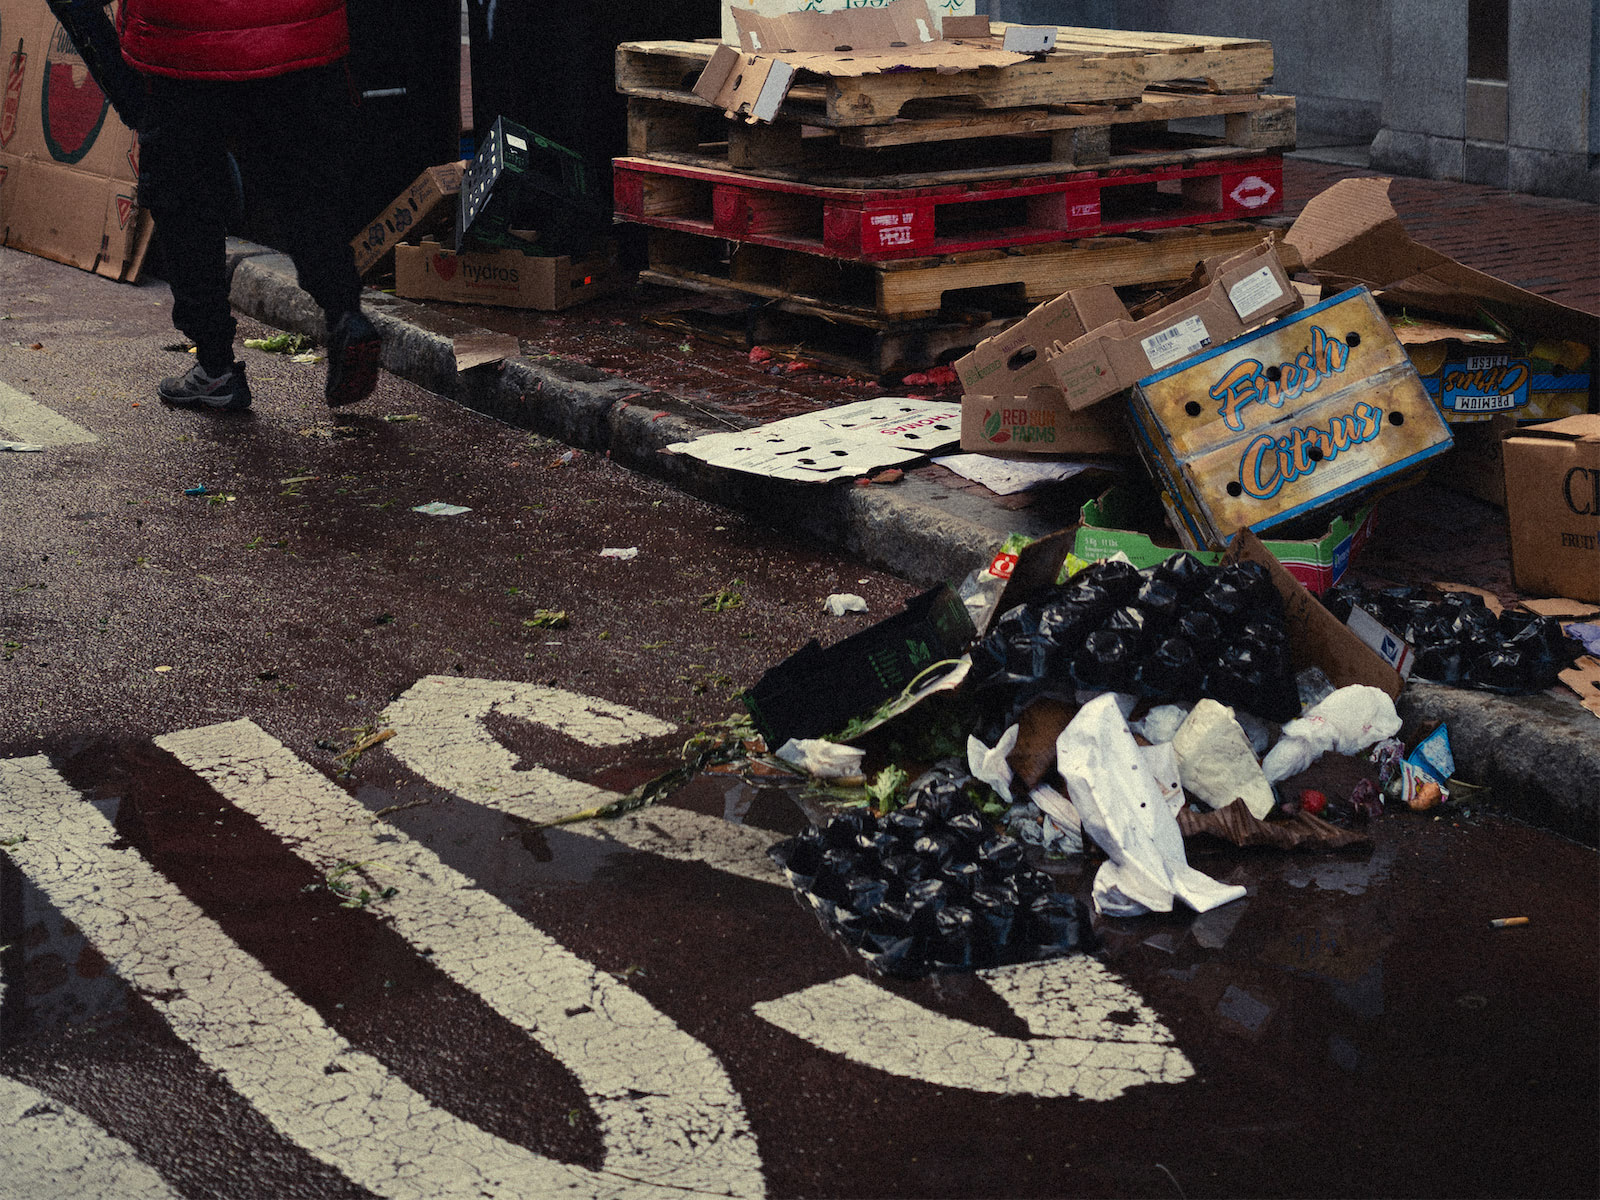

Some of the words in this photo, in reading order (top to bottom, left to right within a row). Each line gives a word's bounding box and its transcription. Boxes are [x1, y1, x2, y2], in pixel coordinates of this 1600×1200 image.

[462, 260, 520, 283] hydros
[1471, 356, 1509, 370] FRESH
[1209, 325, 1350, 432] Fresh
[1444, 364, 1529, 396] Citrus
[1460, 395, 1510, 409] PREMIUM
[880, 412, 958, 436] THOMAS
[1002, 408, 1027, 426] RED
[1012, 426, 1056, 444] FARMS
[1239, 401, 1383, 500] Citrus
[1561, 532, 1595, 550] FRUIT
